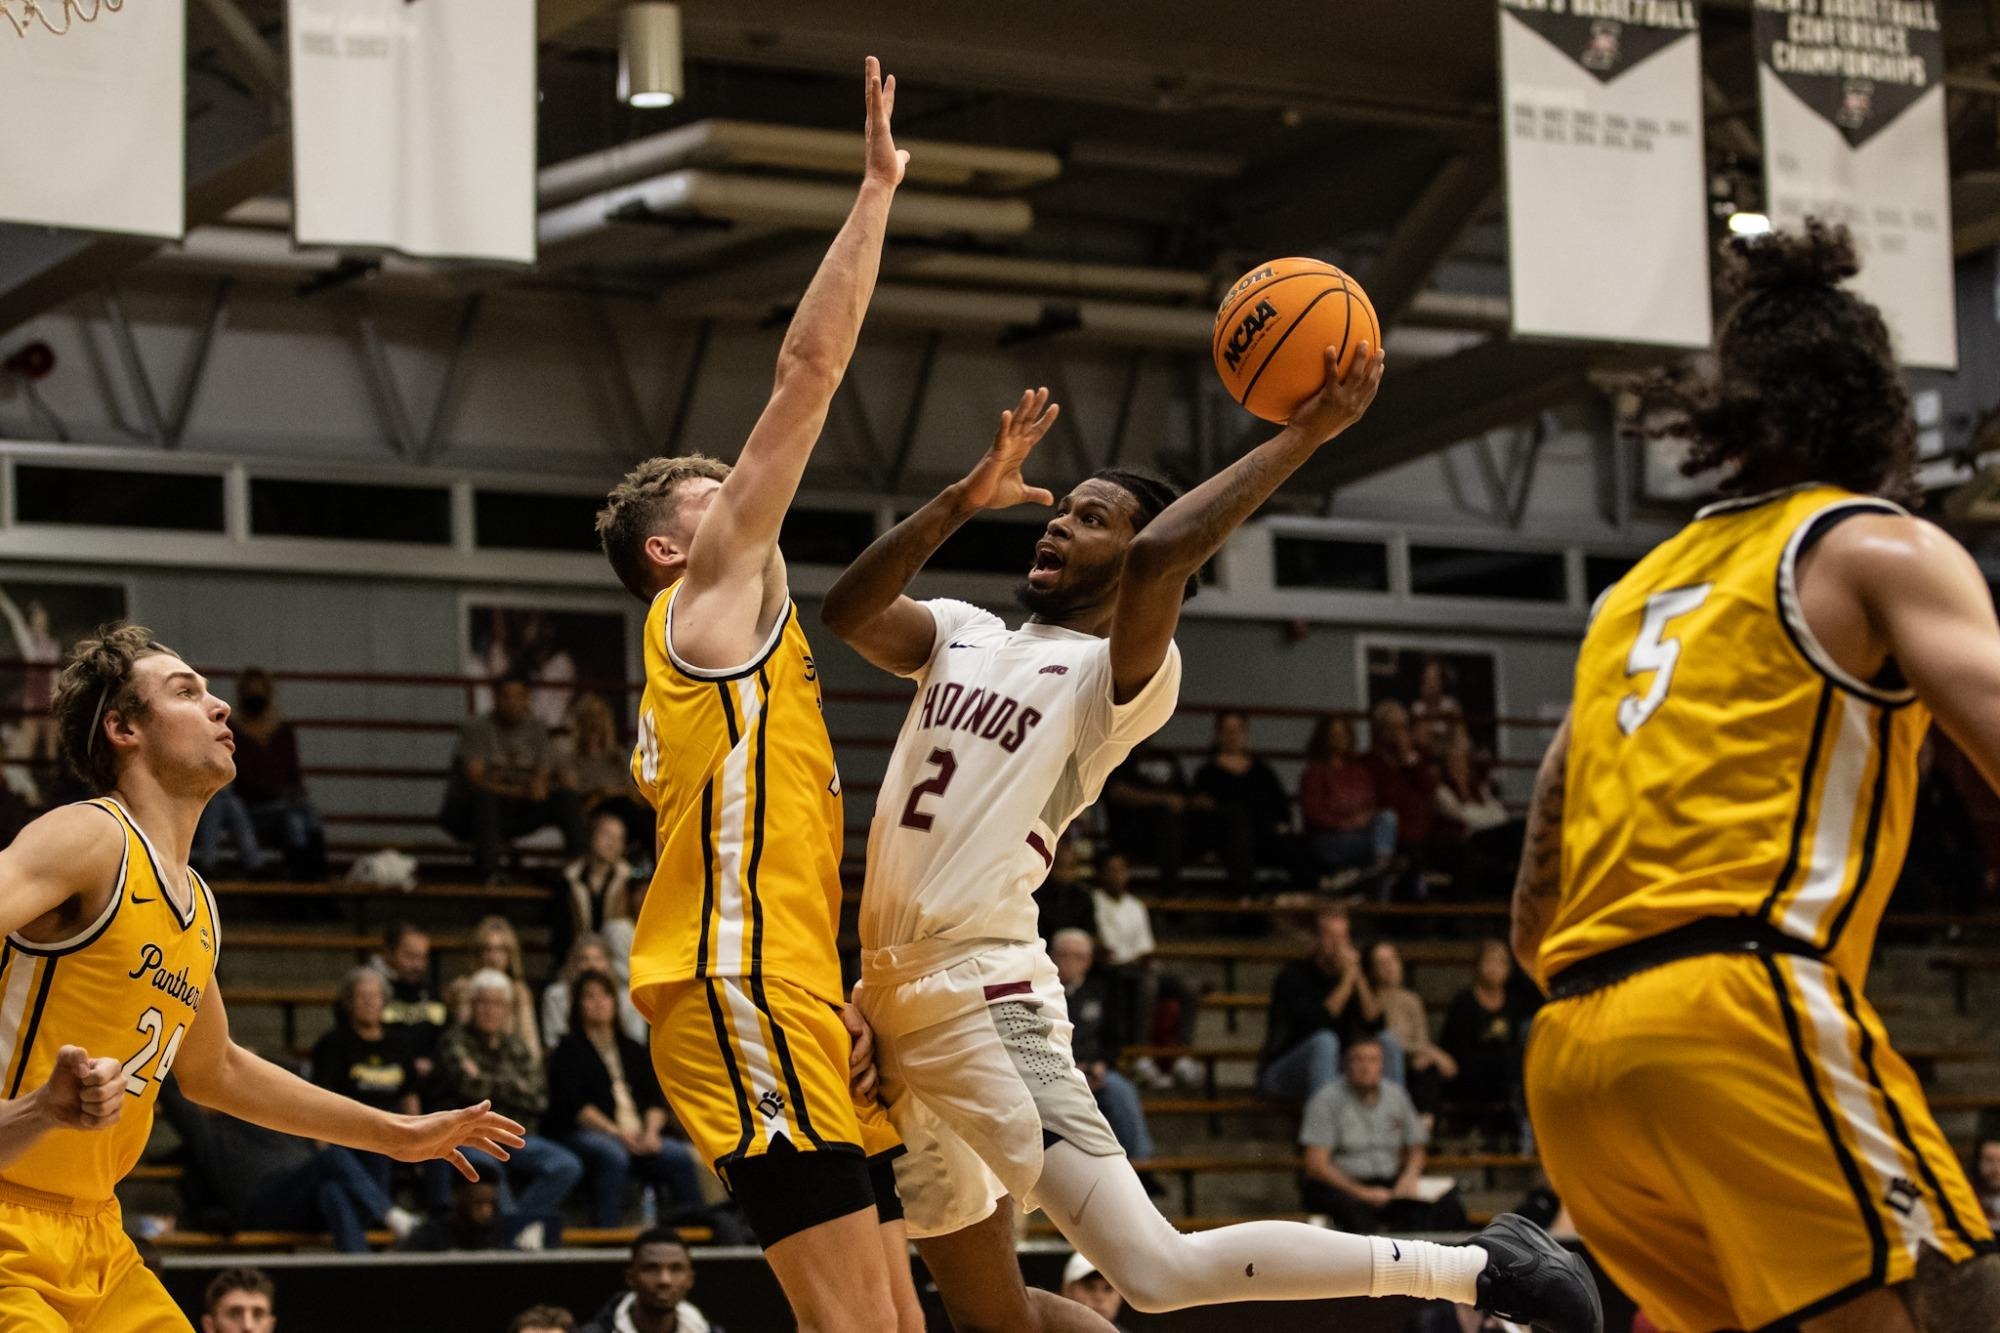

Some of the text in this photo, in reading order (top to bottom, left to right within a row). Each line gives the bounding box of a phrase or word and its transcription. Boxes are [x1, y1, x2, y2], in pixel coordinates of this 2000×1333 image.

[1223, 298, 1278, 373] NCAA
[1616, 579, 1714, 736] 5
[899, 746, 958, 833] 2
[128, 943, 202, 1013] Panther
